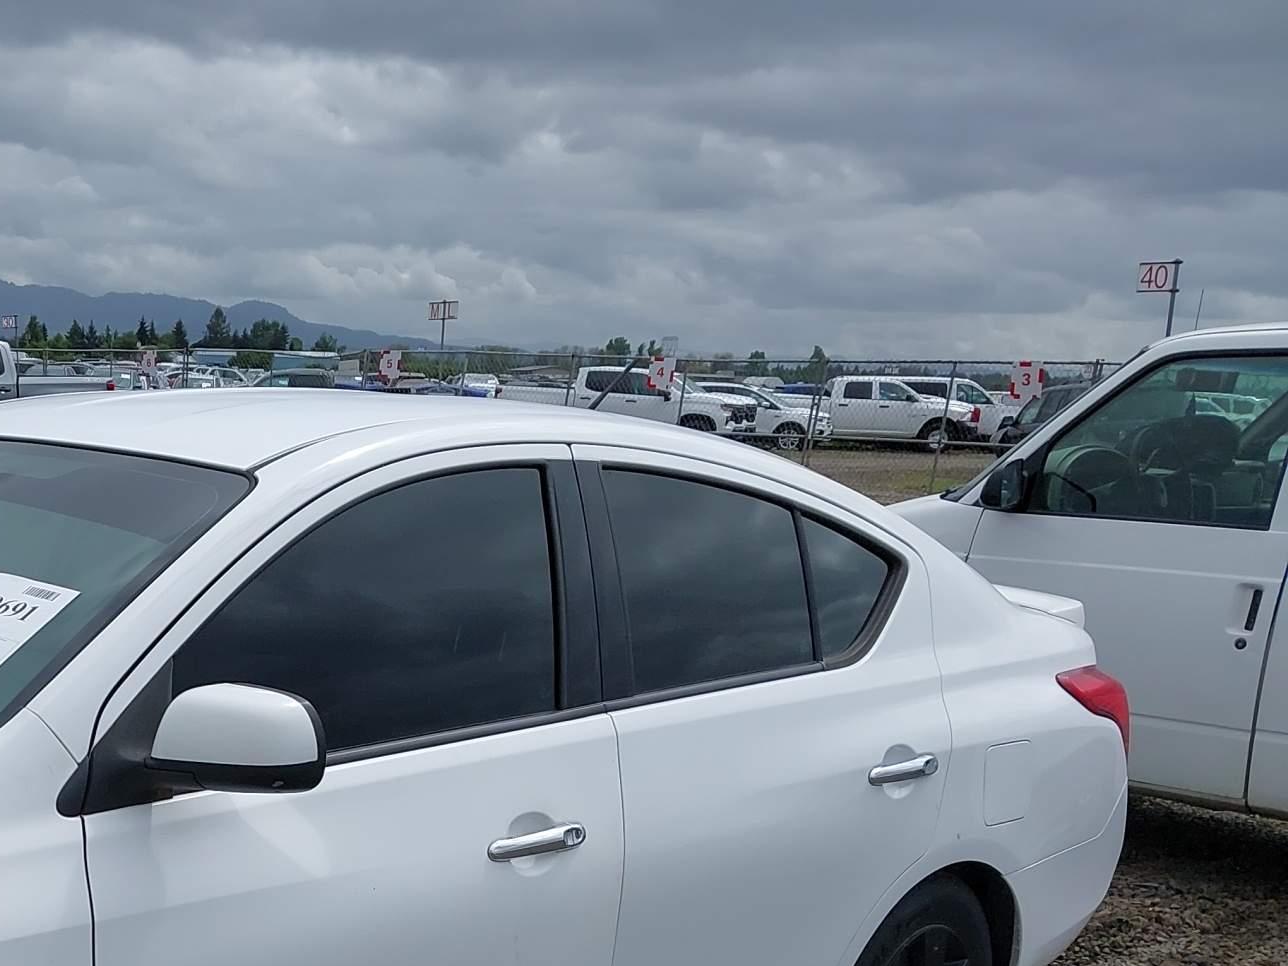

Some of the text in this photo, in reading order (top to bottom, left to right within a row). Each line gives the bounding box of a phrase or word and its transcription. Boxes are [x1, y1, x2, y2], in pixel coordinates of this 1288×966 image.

[1140, 265, 1168, 289] 40
[386, 359, 393, 369] 5
[656, 367, 665, 378] 4
[1021, 373, 1031, 386] 3
